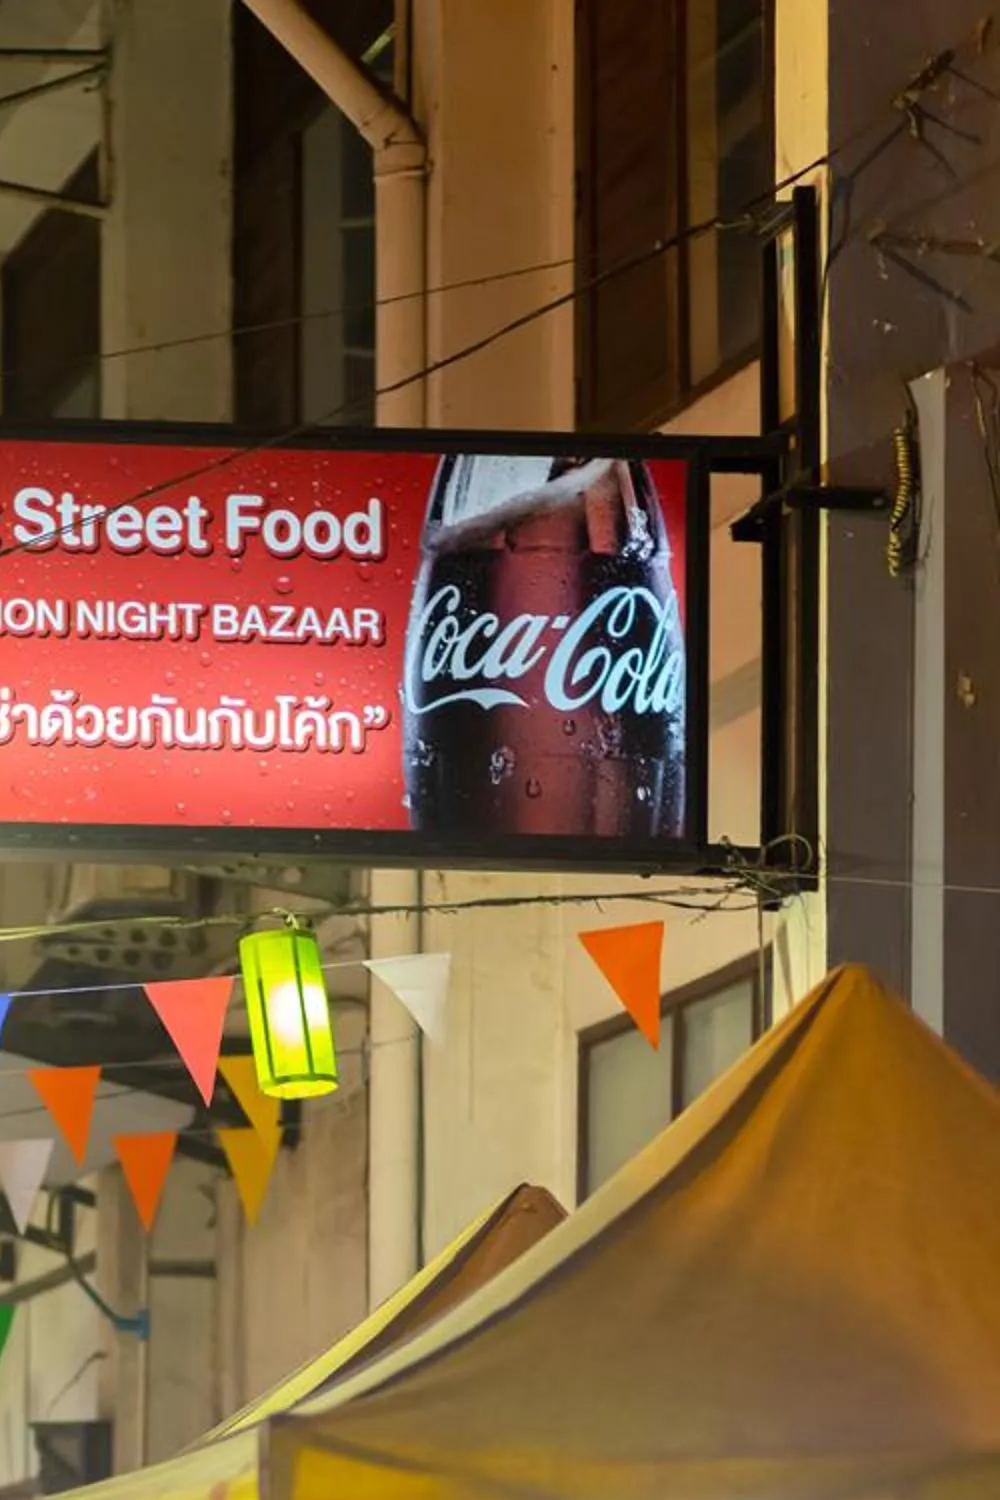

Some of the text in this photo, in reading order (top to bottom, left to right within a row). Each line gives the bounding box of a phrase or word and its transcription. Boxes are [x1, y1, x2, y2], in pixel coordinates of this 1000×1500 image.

[13, 486, 210, 551] Street
[225, 494, 383, 556] Food
[76, 599, 204, 636] NIGHT
[212, 602, 381, 641] BAZAAR
[404, 584, 685, 714] Coca-Cola
